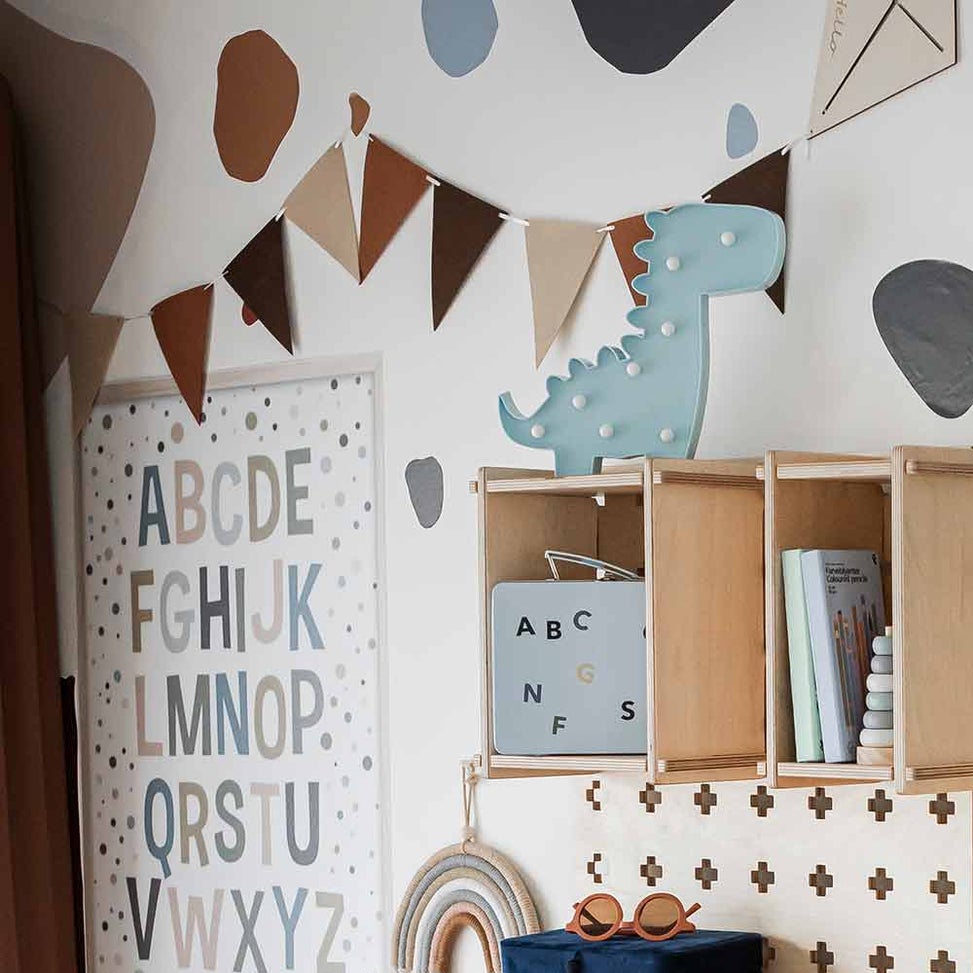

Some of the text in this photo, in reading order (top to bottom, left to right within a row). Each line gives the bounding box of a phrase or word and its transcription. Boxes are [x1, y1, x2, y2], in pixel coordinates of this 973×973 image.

[138, 447, 314, 547] ABCDE
[130, 558, 326, 653] FGHIJK
[516, 610, 592, 640] A B C
[134, 668, 325, 760] LMNOP
[523, 683, 542, 704] N
[621, 700, 635, 721] S
[552, 715, 567, 735] F
[143, 776, 321, 880] QRSTU
